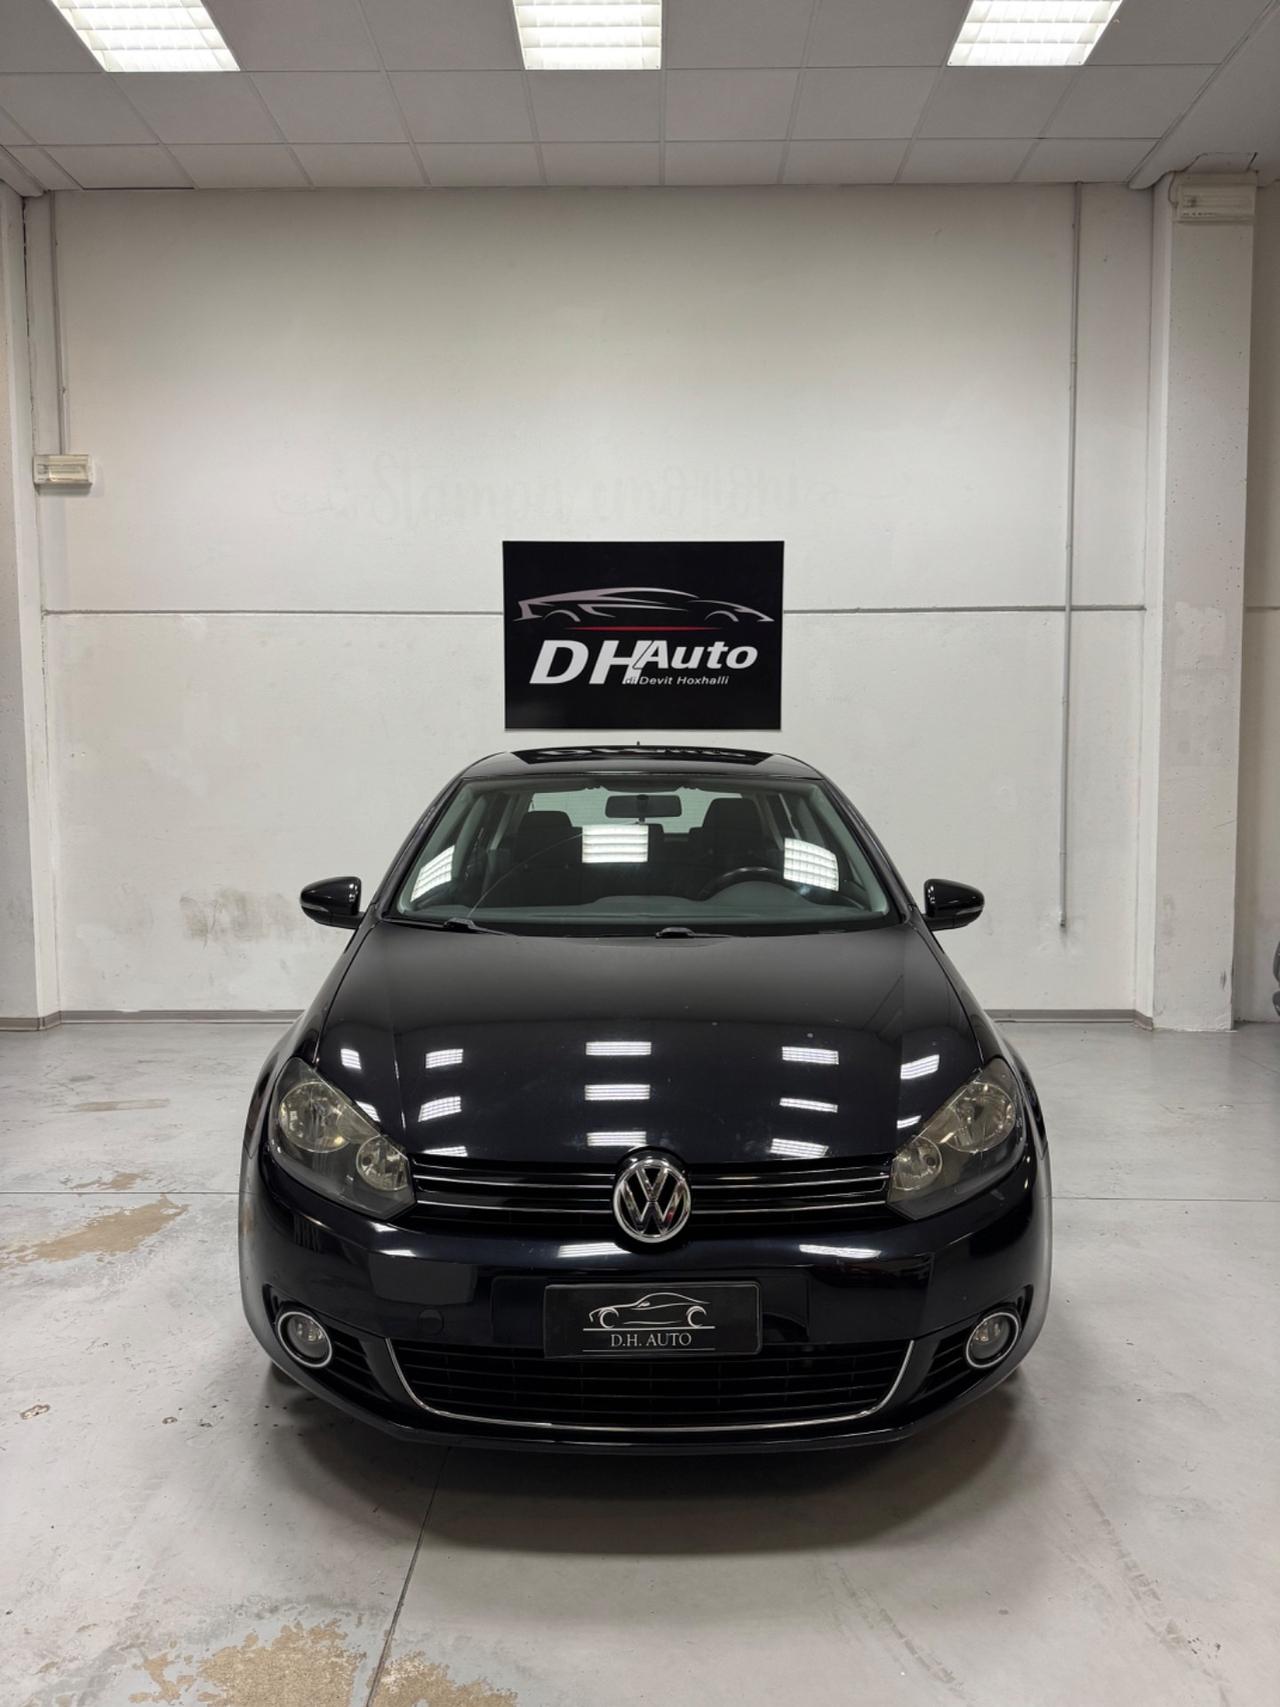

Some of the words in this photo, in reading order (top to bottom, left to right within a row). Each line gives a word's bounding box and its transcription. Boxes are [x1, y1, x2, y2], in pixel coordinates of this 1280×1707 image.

[639, 676, 673, 685] Devit
[676, 675, 729, 685] Hoxhalli
[611, 1334, 642, 1347] D.H.
[646, 1333, 692, 1346] AUTO
